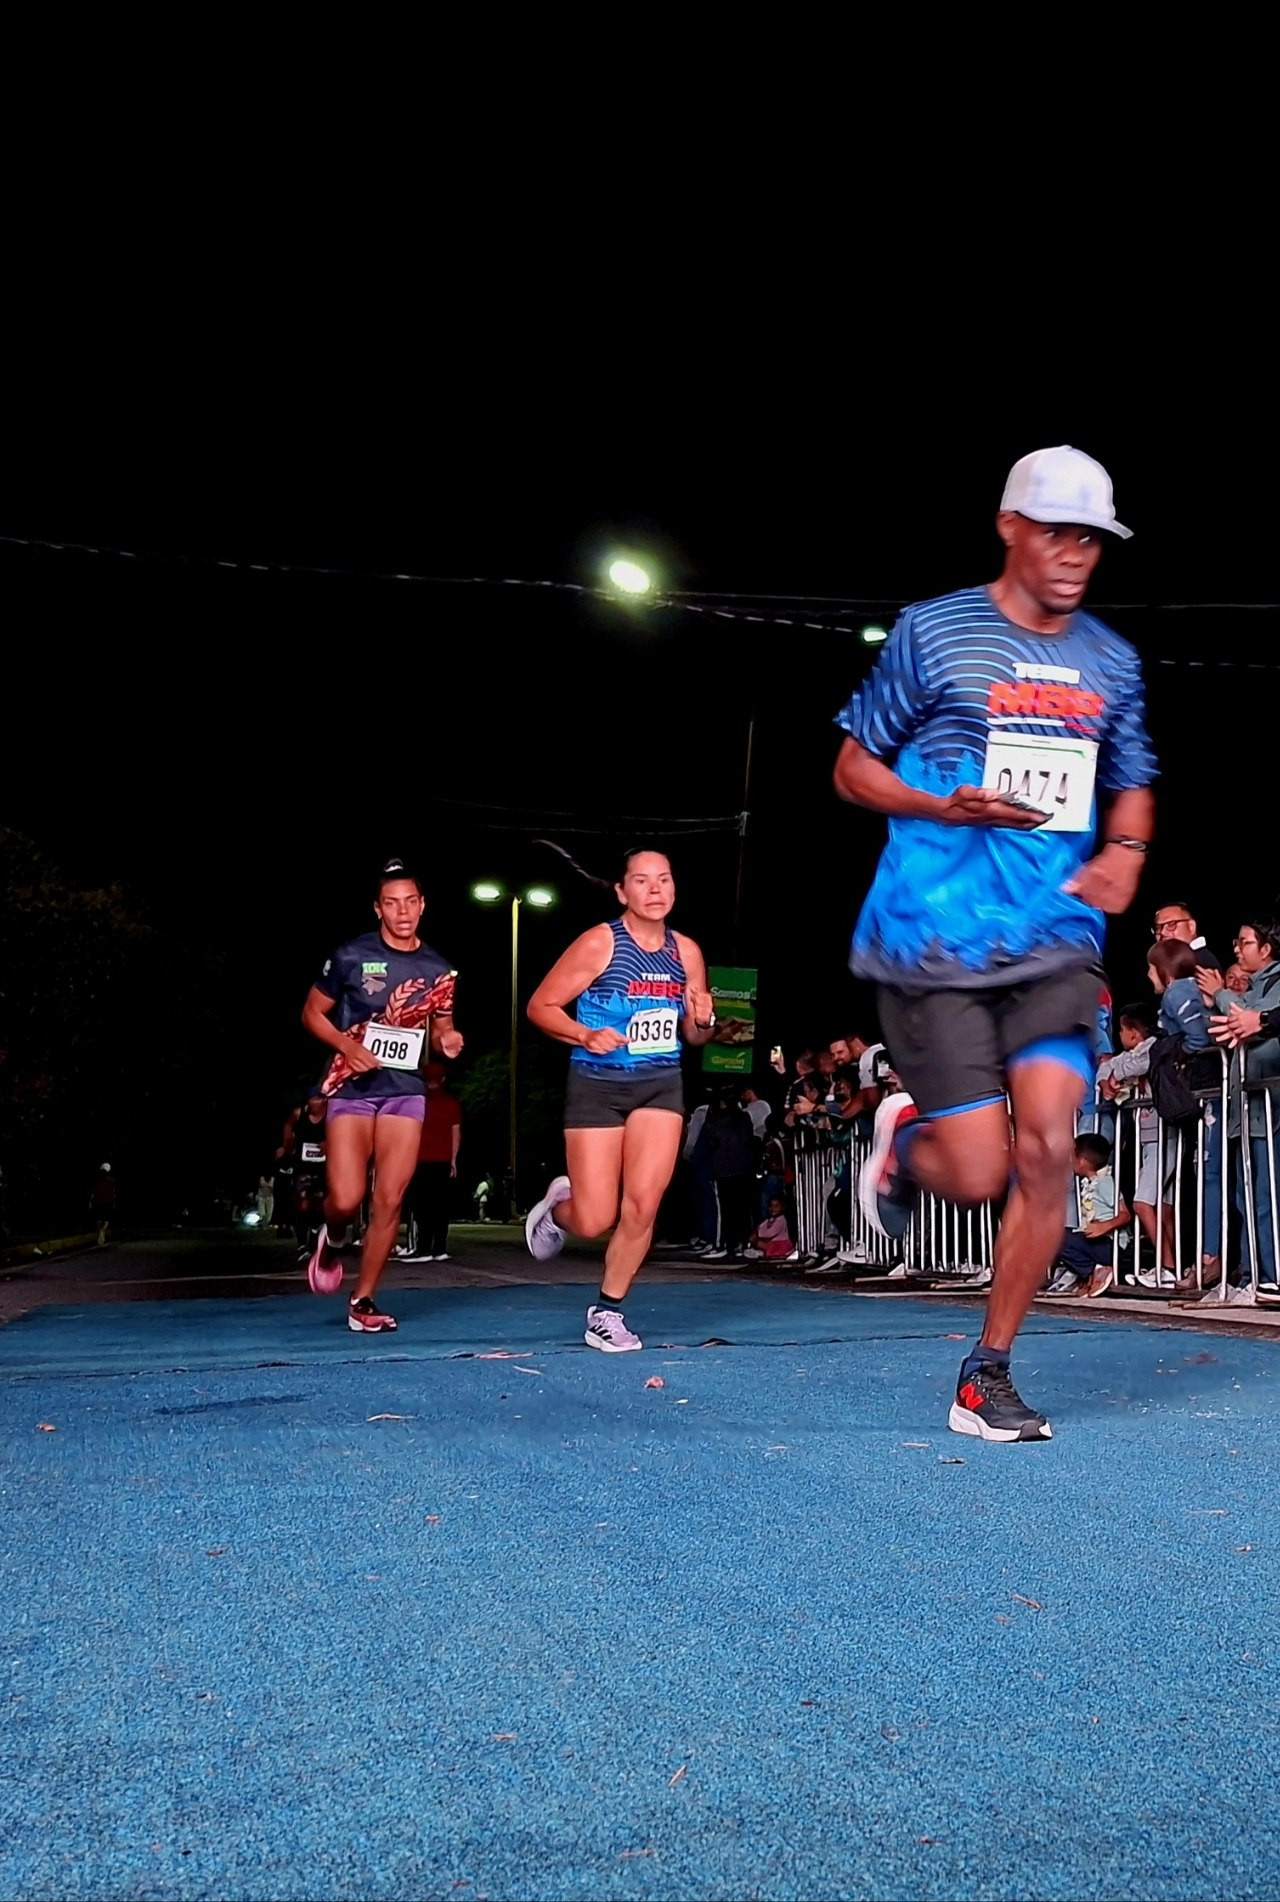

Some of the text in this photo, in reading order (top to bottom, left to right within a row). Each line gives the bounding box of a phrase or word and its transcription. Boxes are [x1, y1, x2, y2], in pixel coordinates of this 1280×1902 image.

[641, 973, 671, 982] TEAM
[629, 1019, 674, 1042] 0336
[371, 1038, 408, 1060] 0198
